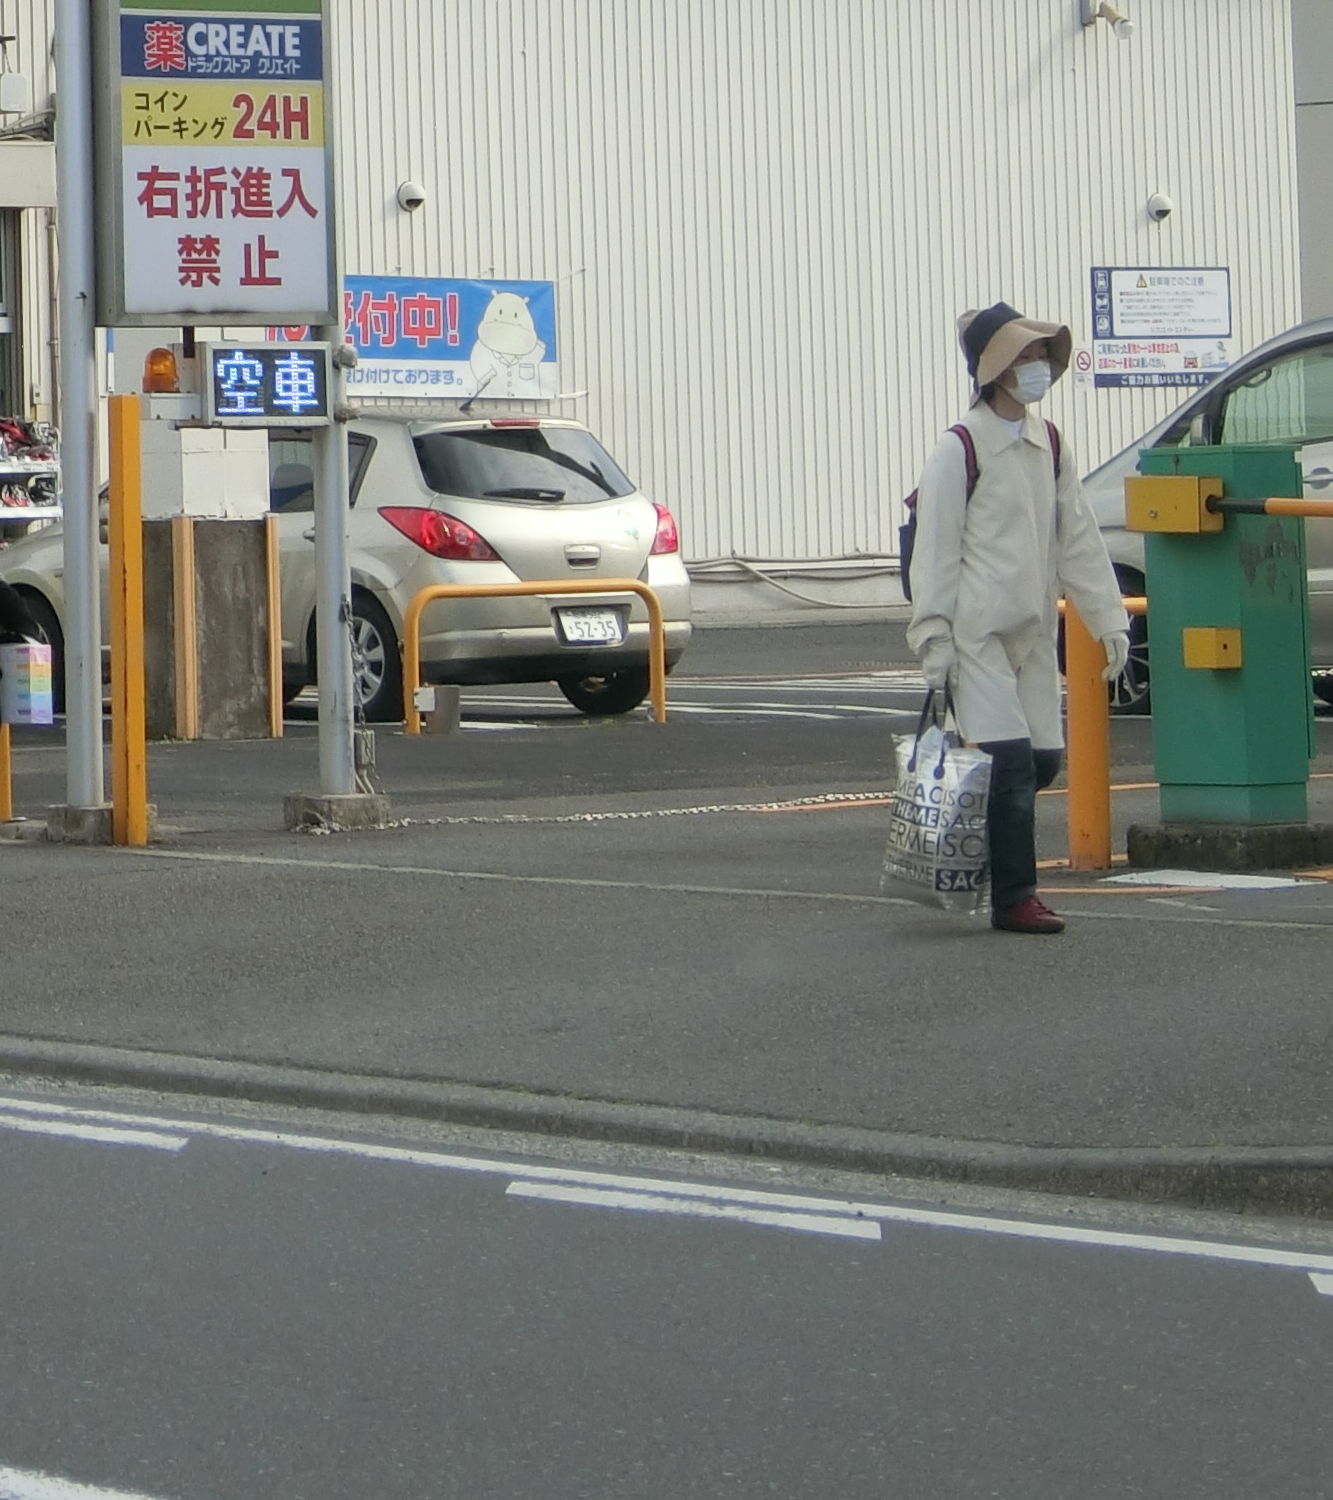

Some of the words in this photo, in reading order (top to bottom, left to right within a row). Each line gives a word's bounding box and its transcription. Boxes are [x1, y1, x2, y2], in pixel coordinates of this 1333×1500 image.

[144, 20, 186, 73] 薬
[186, 22, 301, 57] CREATE
[187, 56, 251, 74] ドラッグストア
[258, 58, 301, 75] クリエイト
[134, 90, 188, 113] コイン
[232, 93, 310, 140] 24H
[134, 115, 227, 139] パーキング
[136, 164, 319, 222] 右折進入
[177, 233, 283, 288] 禁止
[215, 350, 319, 414] 空車
